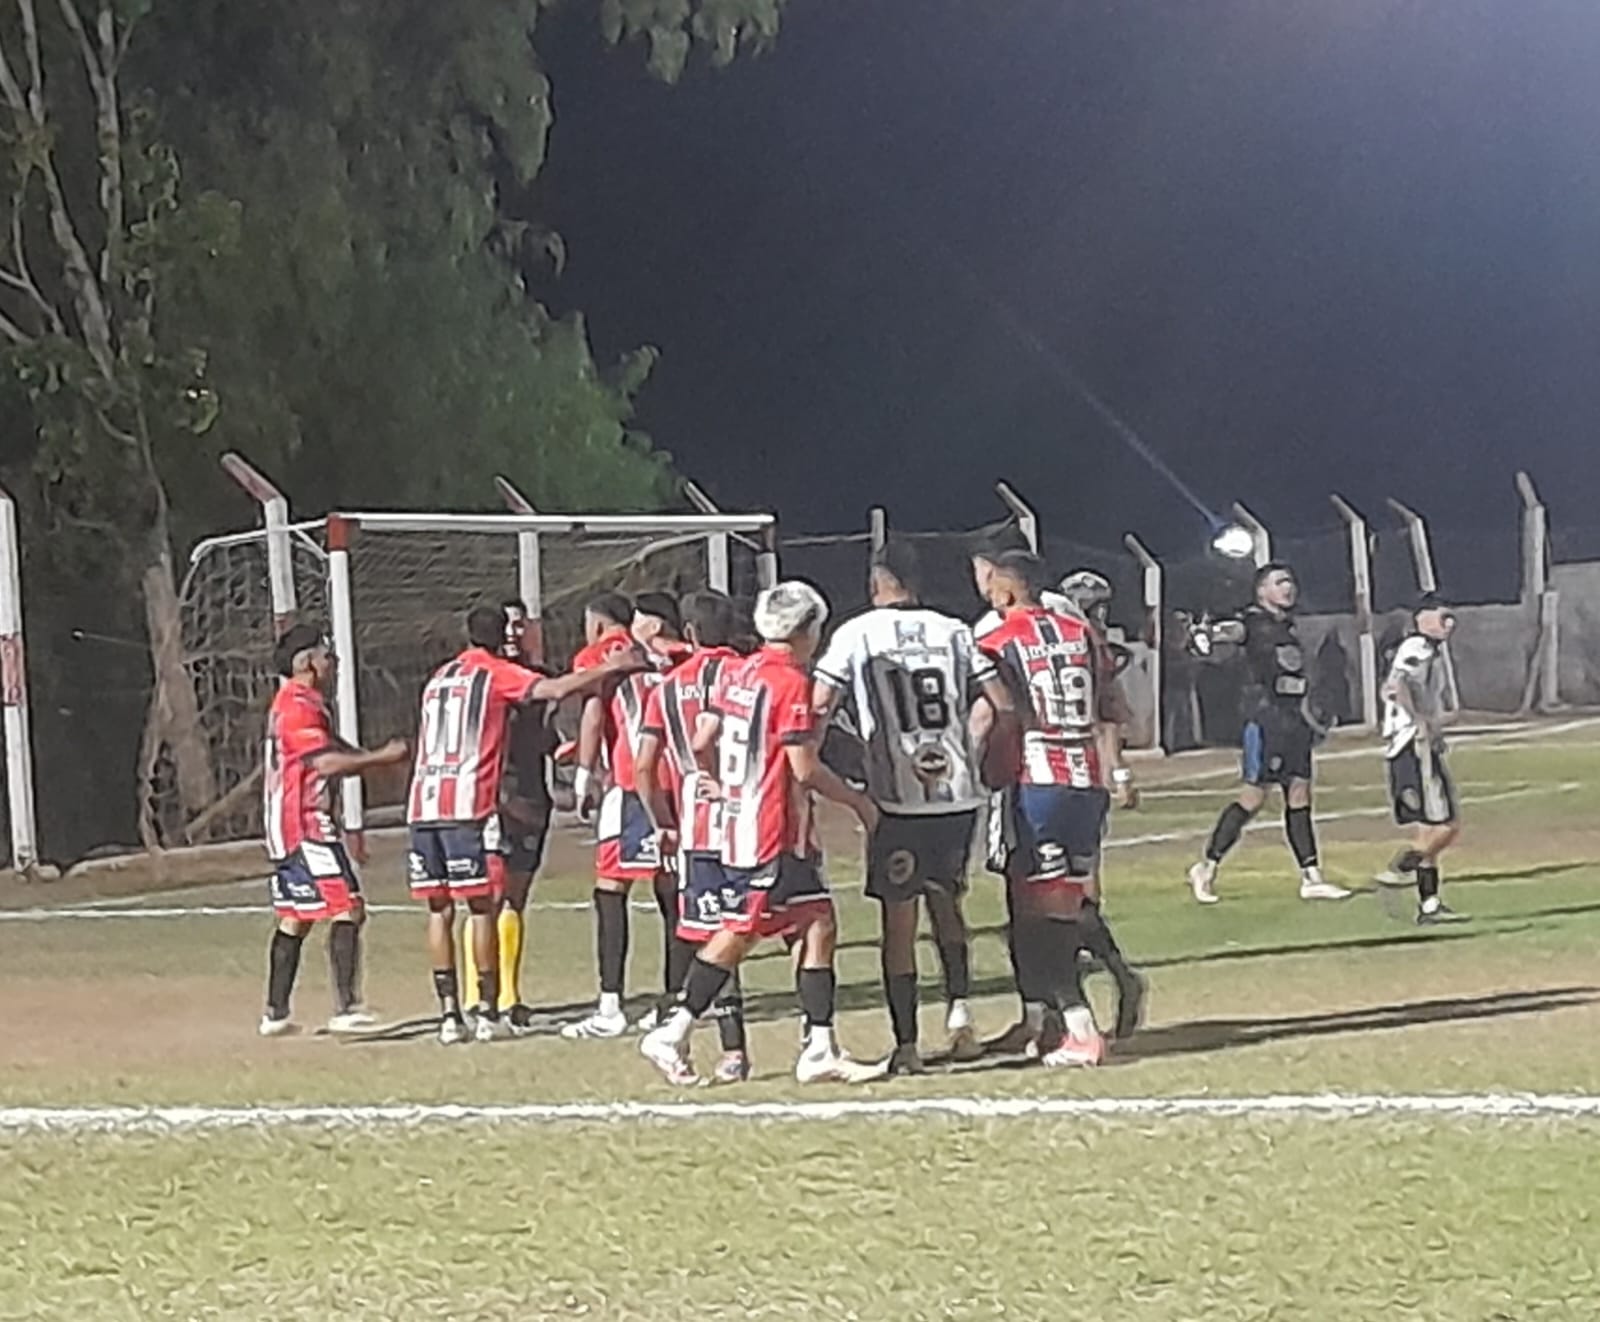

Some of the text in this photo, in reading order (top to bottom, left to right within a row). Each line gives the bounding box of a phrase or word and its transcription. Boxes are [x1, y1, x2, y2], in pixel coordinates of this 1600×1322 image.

[425, 696, 462, 754] 11
[886, 668, 949, 732] 18
[720, 714, 749, 786] 6
